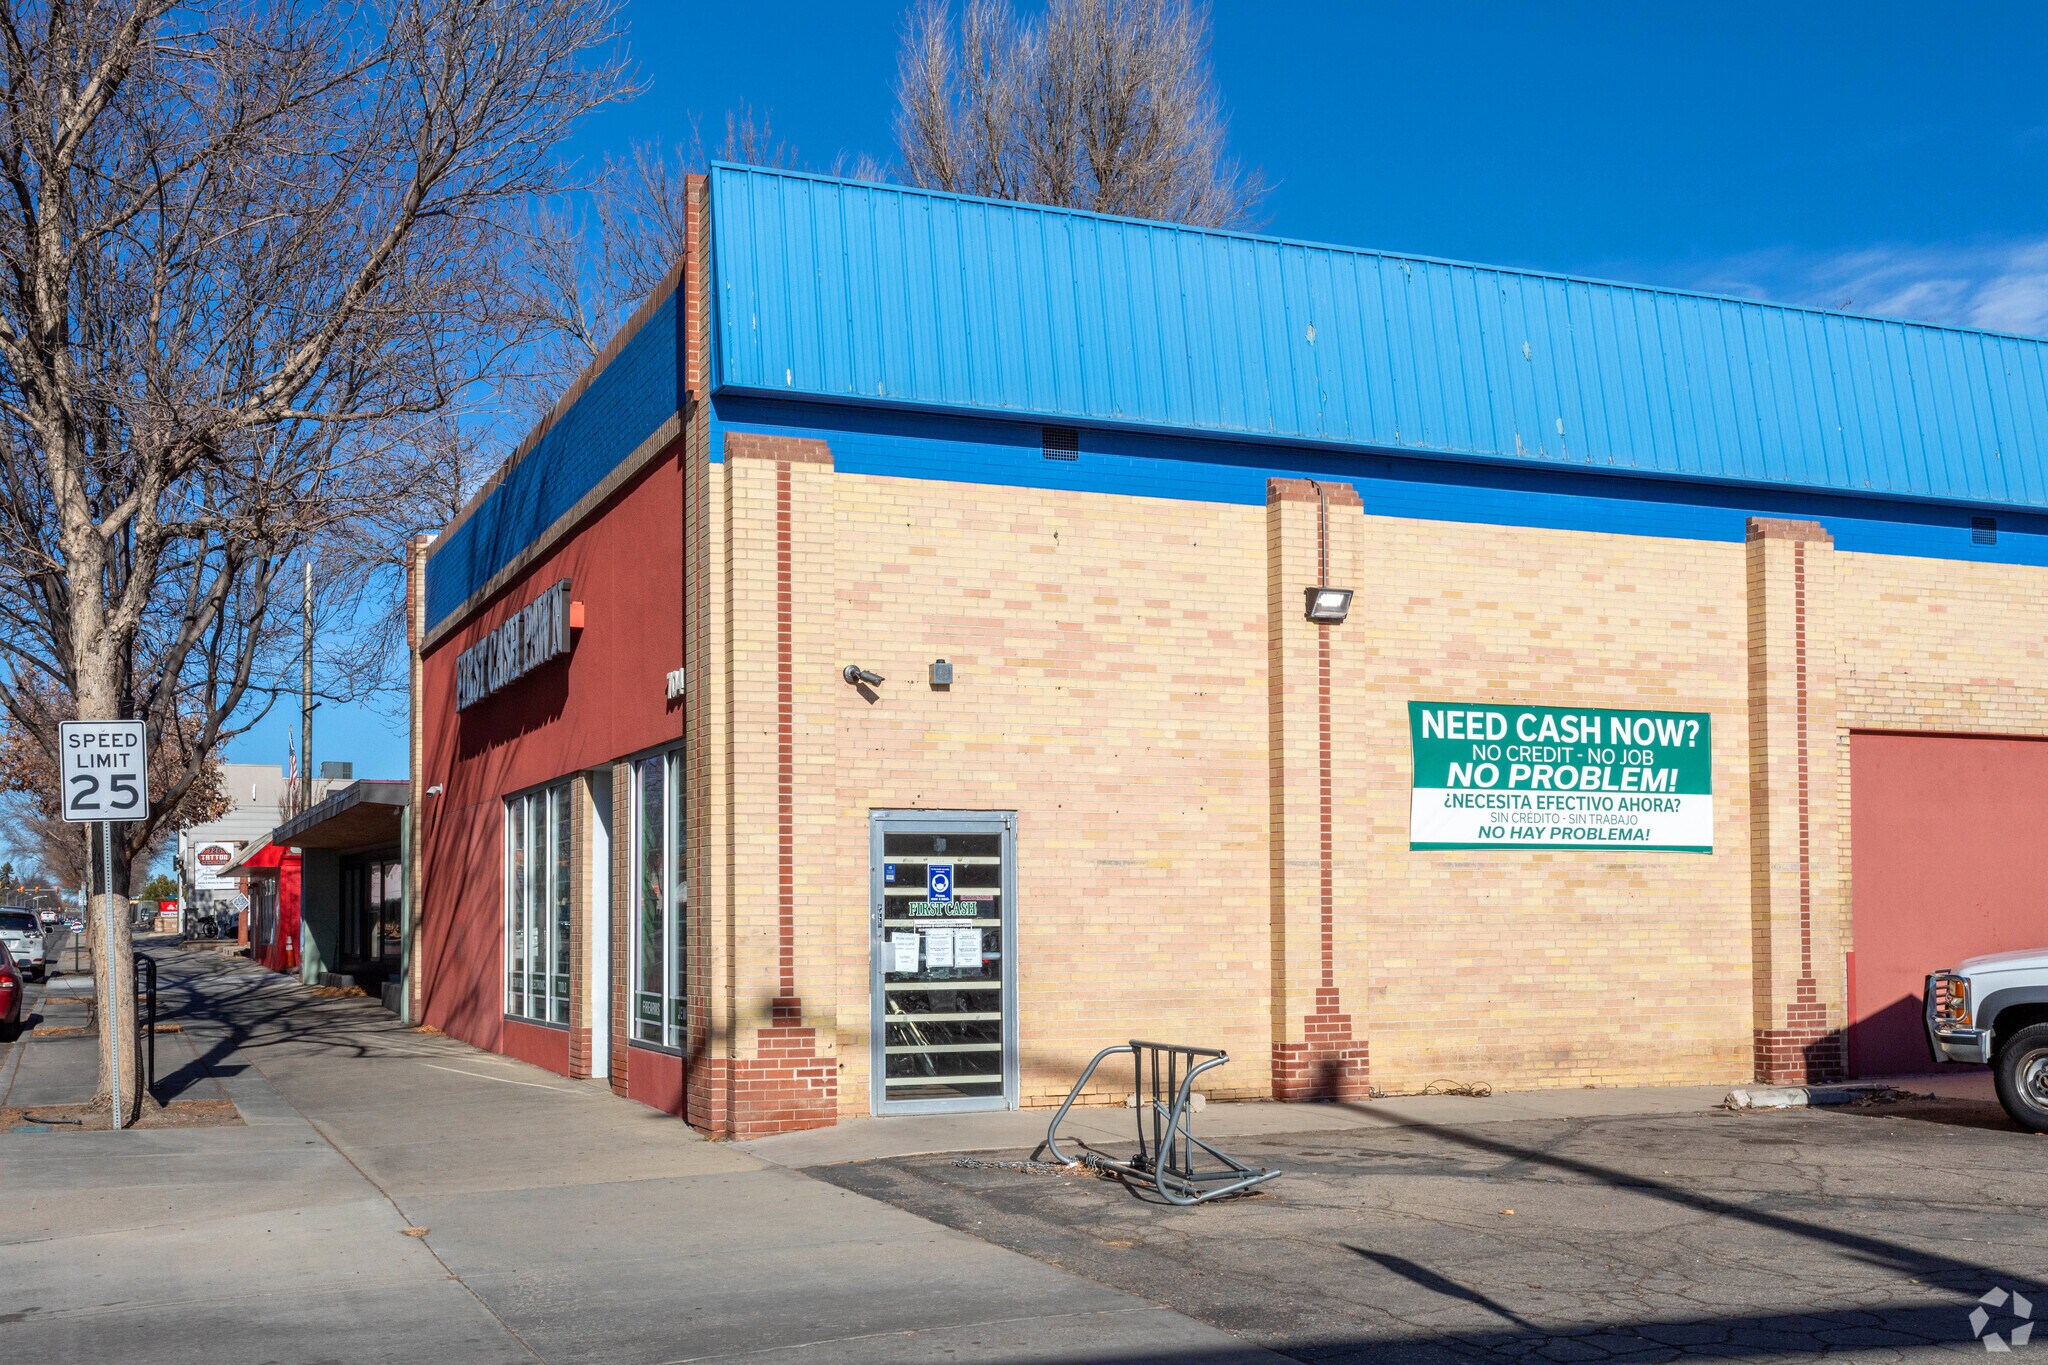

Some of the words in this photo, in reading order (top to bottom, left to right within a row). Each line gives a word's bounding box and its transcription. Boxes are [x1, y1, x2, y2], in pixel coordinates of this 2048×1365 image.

[456, 636, 487, 713] FIRST
[488, 611, 520, 694] CASH
[523, 579, 563, 673] PAWN
[1422, 709, 1508, 741] NEED
[1516, 713, 1601, 744] CASH
[1610, 716, 1700, 748] NOW?
[69, 733, 138, 749] SPEED
[77, 753, 130, 768] LIMIT
[1472, 744, 1501, 761] NO
[1506, 745, 1574, 763] CREDIT
[1587, 748, 1616, 764] NO
[1619, 749, 1654, 766] JOB
[1446, 762, 1500, 788] NO
[1508, 763, 1679, 793] PROBLEM!
[69, 774, 139, 810] 25
[1444, 793, 1532, 810] ¿NECESITA
[1536, 795, 1614, 811] EFECTIVO
[1617, 797, 1681, 813] AHORA?
[1490, 811, 1509, 823] SIN
[1511, 810, 1560, 824] CRÉDITO
[1568, 813, 1587, 825] SIN
[1589, 813, 1638, 826] TRABAJO
[1478, 825, 1506, 839] NO
[1509, 826, 1547, 840] HAY
[1549, 826, 1650, 841] PROBLEMA!
[909, 902, 943, 916] FIRST
[945, 902, 977, 916] CASH
[642, 1000, 661, 1017] FIREARMS
